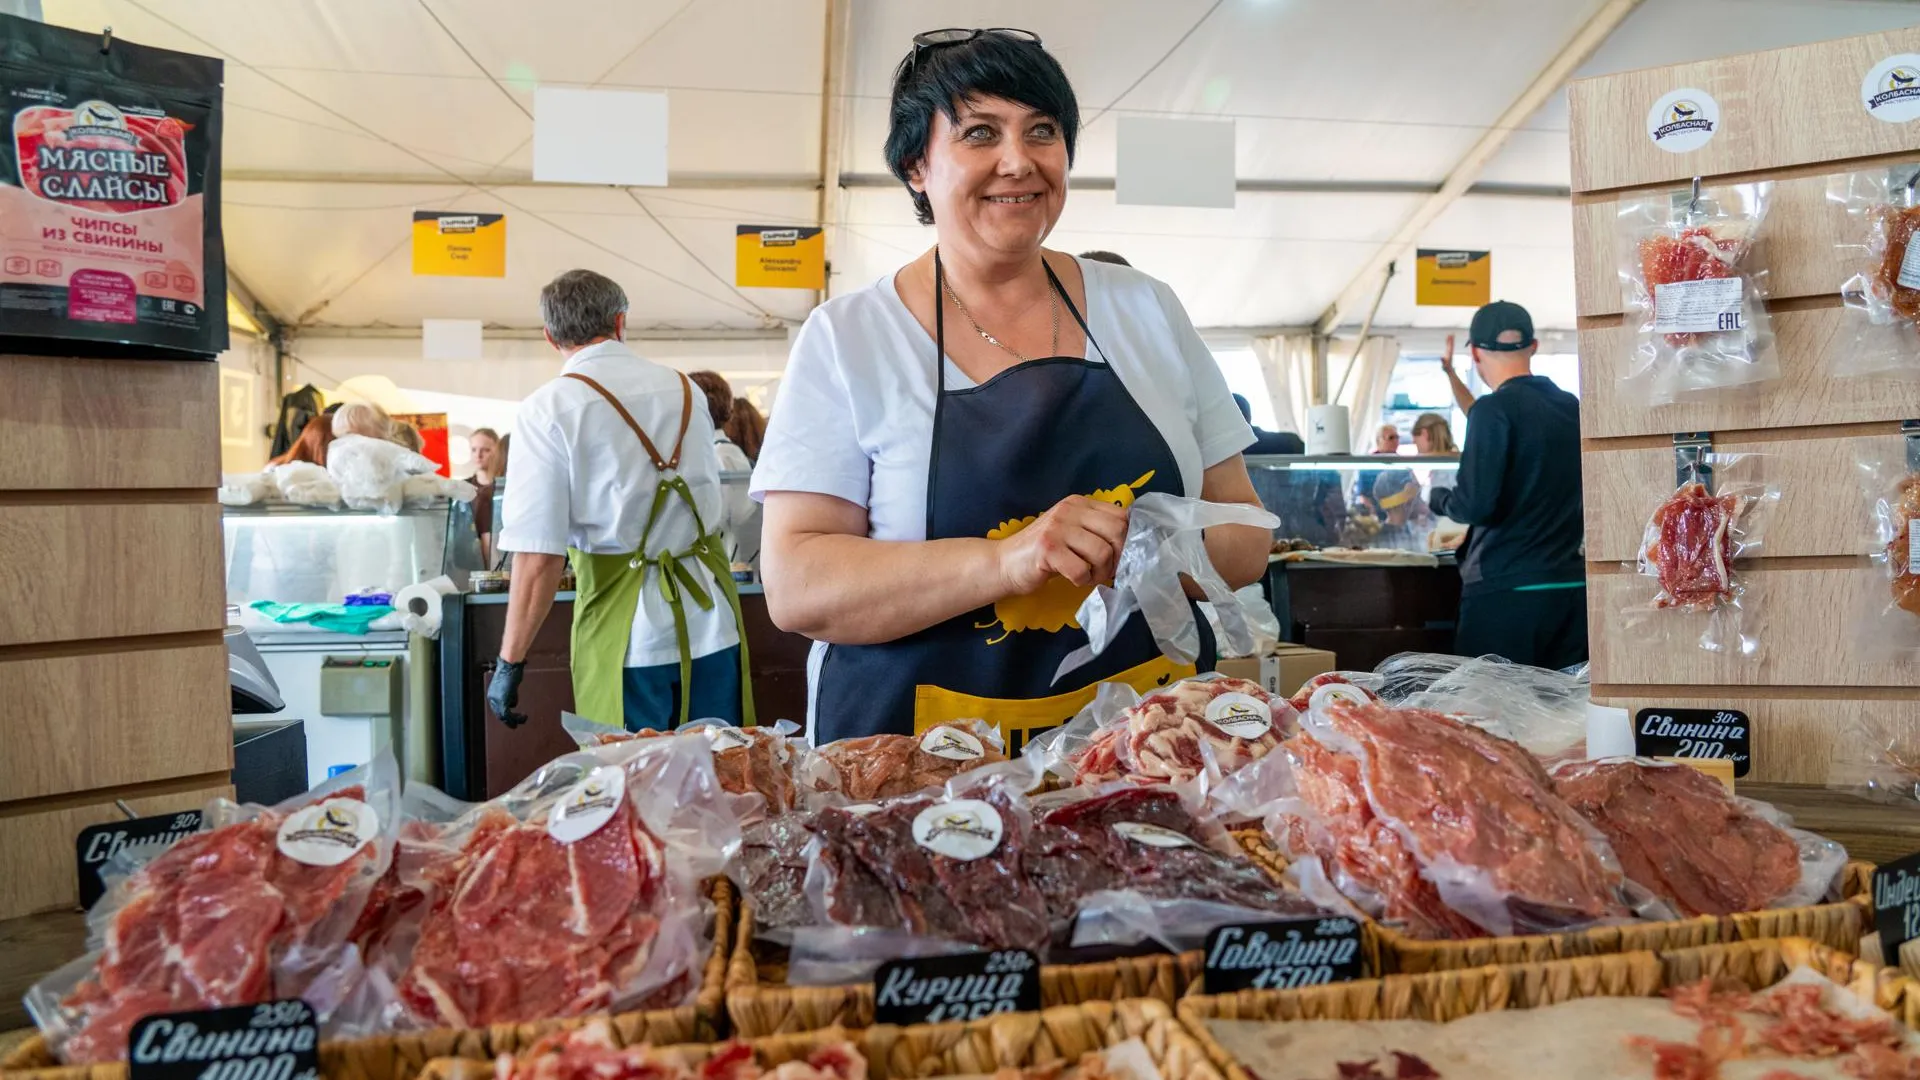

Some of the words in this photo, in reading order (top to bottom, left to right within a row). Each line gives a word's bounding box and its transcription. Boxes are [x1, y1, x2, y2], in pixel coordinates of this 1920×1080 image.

[1660, 120, 1707, 134] КОЛБАСНАЯ
[40, 147, 170, 177] МЯСНЫЕ
[42, 174, 169, 204] СЛАЙСЫ
[71, 216, 138, 236] ЧИПСЫ
[42, 227, 66, 241] ИЗ
[72, 231, 163, 254] СВИНИНЫ
[1641, 715, 1745, 740] Свинина
[1674, 738, 1724, 759] 200
[1206, 926, 1359, 969] Говядина
[877, 967, 1023, 1006] Курица
[134, 1019, 315, 1064] Свинина
